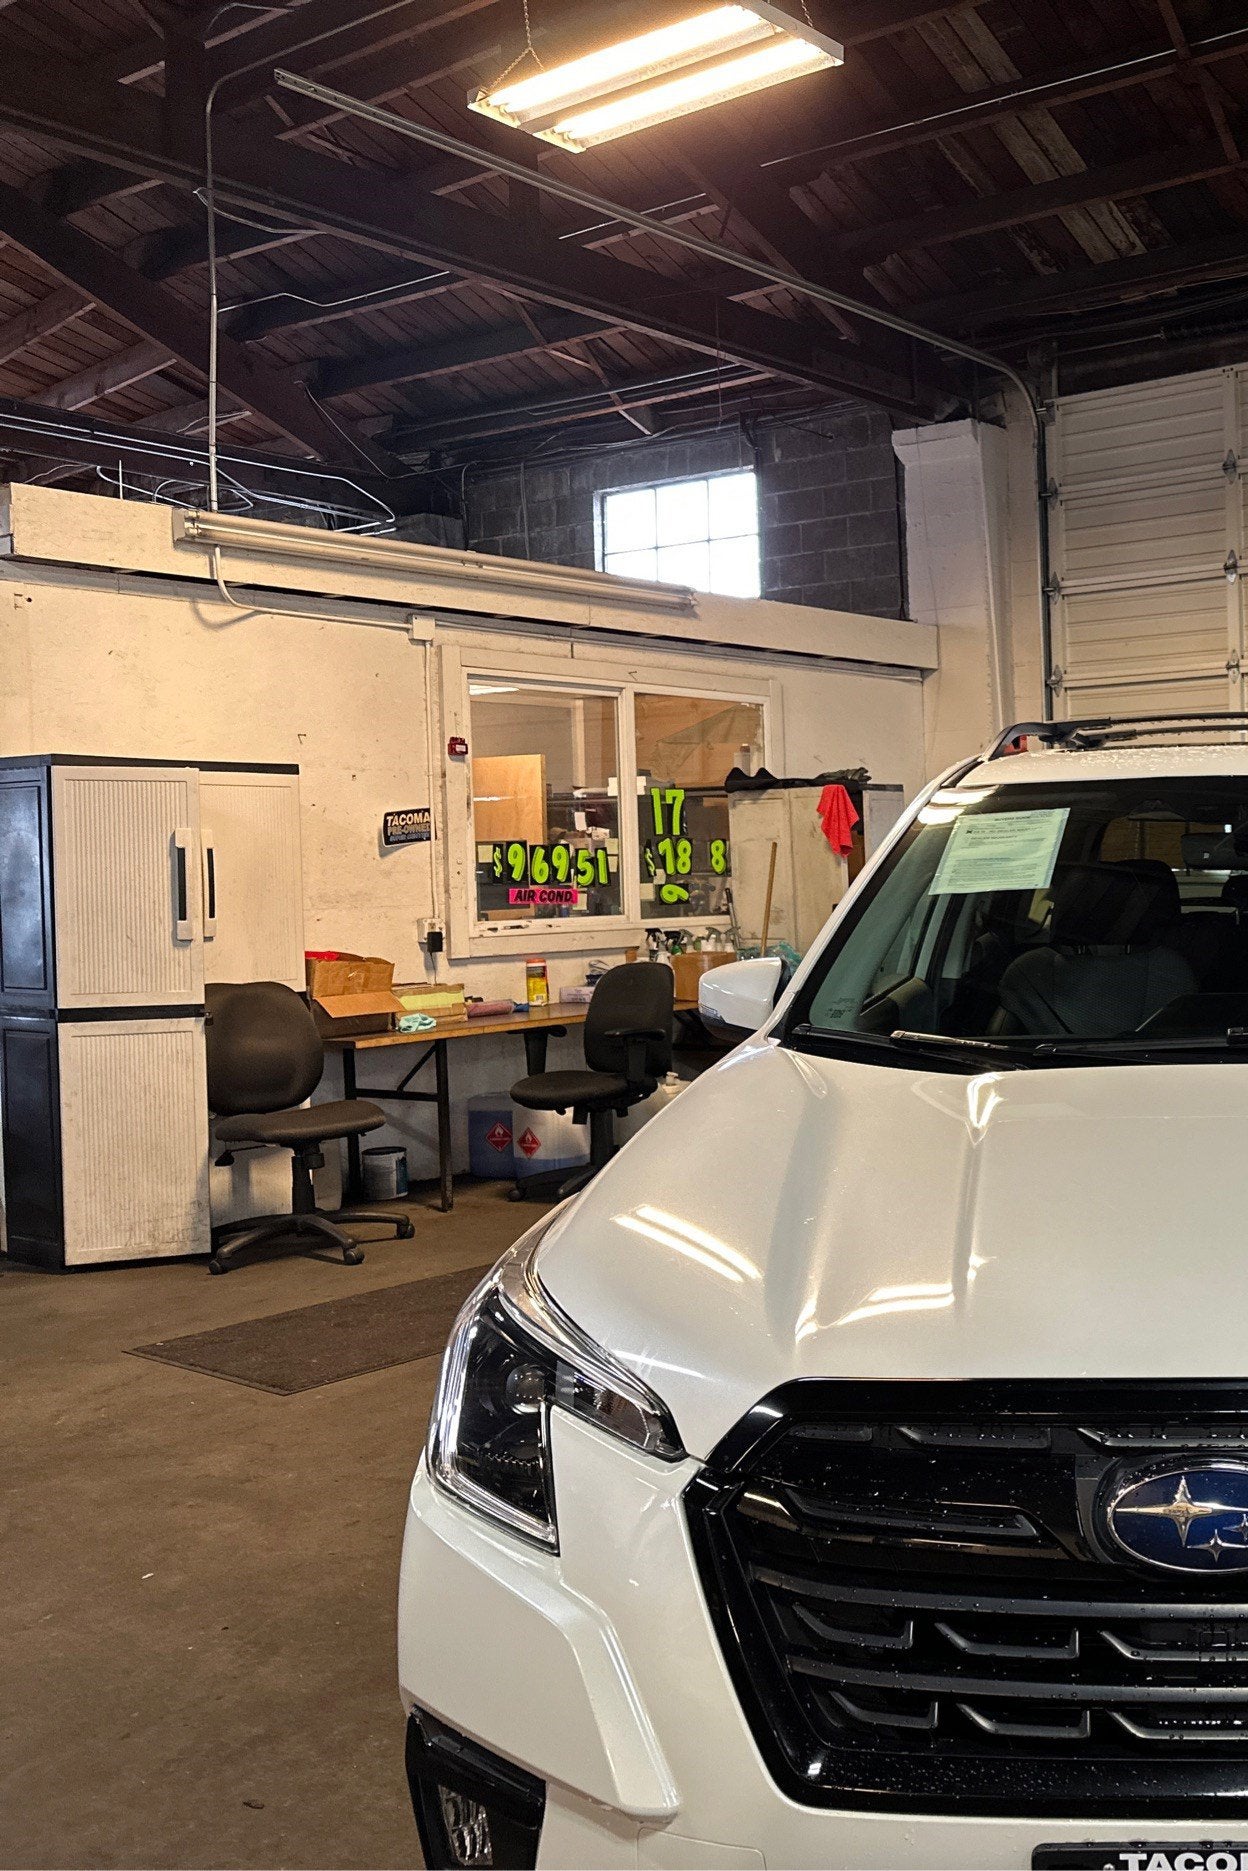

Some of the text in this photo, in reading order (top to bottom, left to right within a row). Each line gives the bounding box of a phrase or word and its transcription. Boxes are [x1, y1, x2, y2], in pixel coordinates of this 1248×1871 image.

[386, 812, 430, 827] TACOMA
[651, 788, 685, 835] 17
[711, 840, 726, 875] 8
[514, 889, 536, 902] AIR
